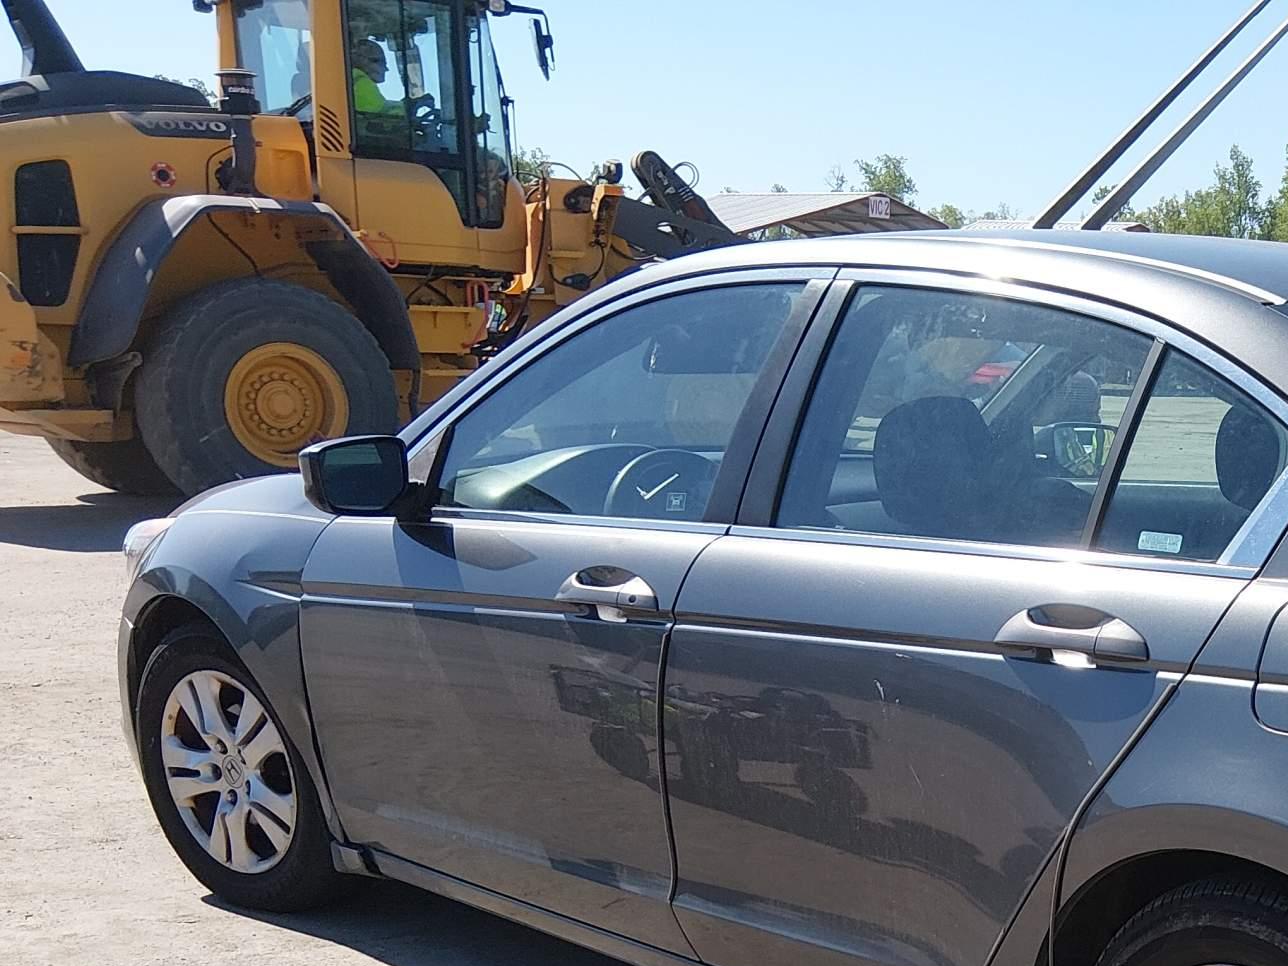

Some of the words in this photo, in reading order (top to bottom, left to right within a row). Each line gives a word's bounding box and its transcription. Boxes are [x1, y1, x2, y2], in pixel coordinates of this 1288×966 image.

[143, 120, 227, 132] VOLVO
[870, 200, 882, 216] VIC
[884, 201, 889, 216] 2
